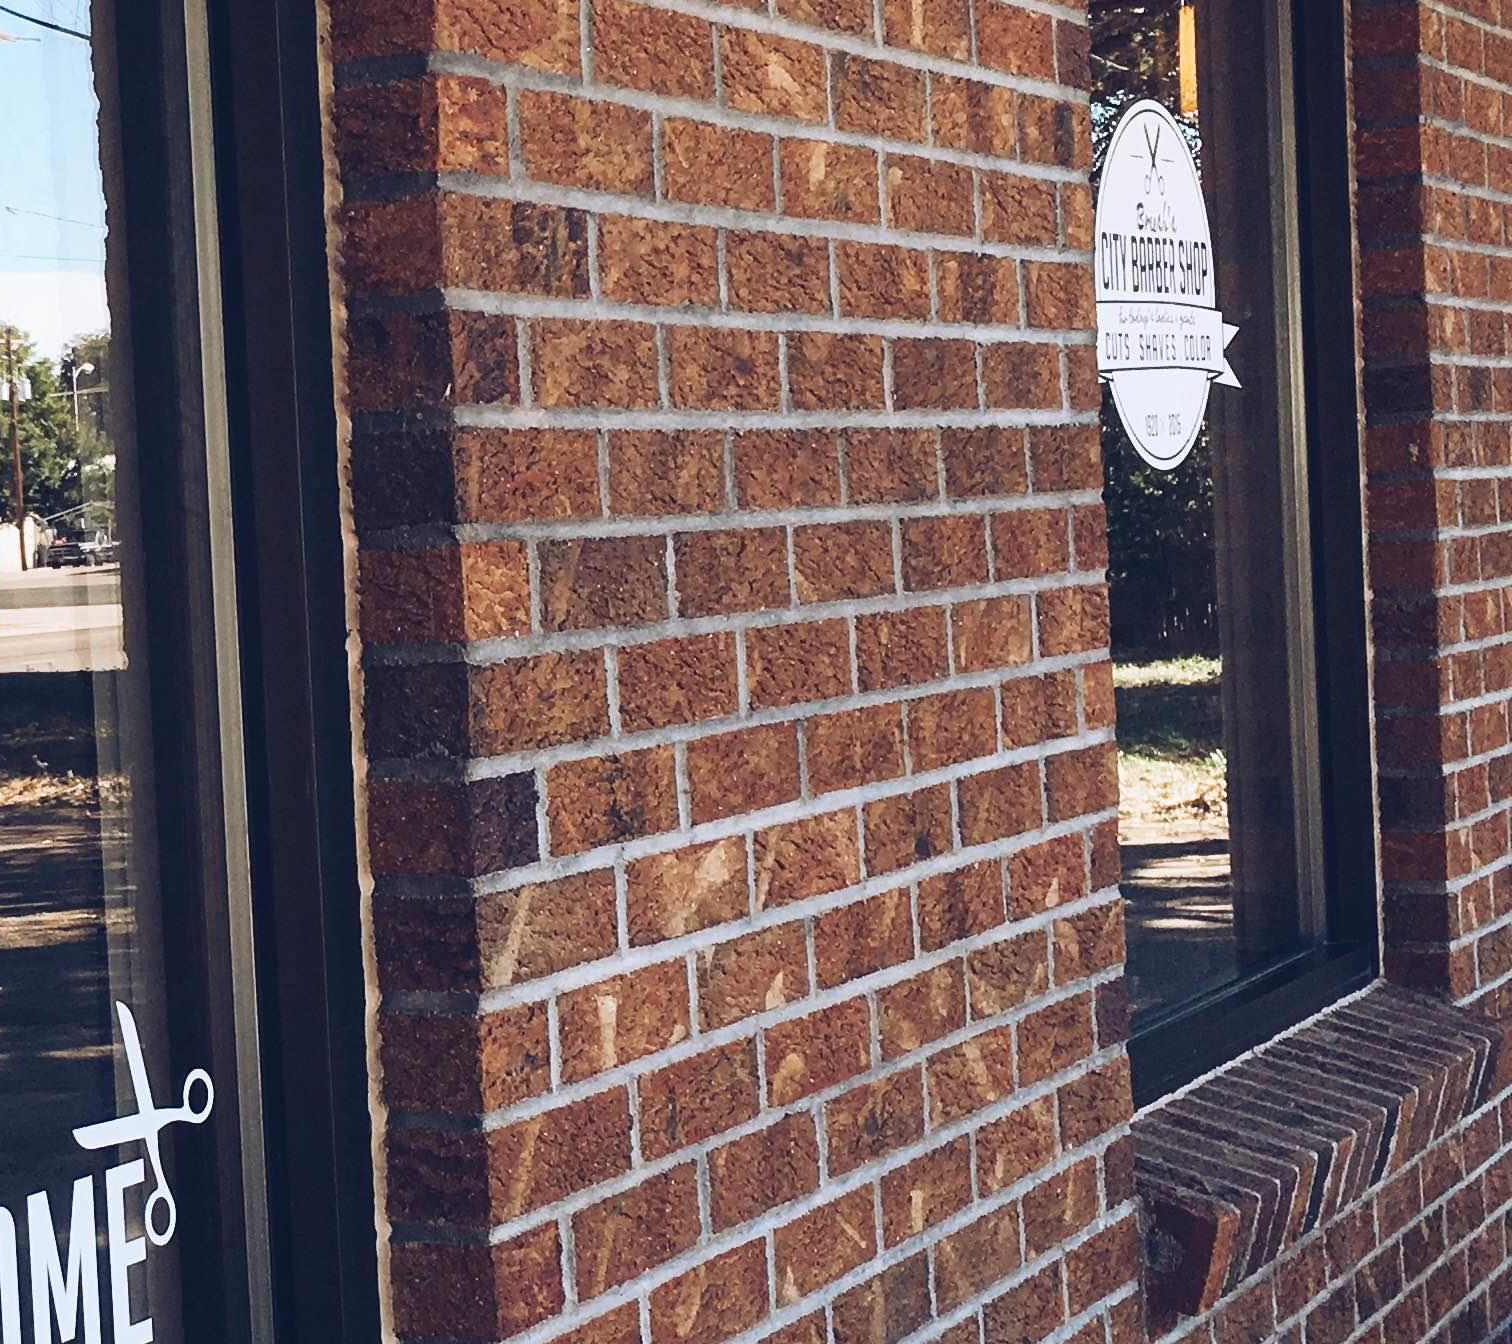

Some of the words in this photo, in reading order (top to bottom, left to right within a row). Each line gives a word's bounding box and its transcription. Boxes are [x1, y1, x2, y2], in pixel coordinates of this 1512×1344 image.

[1101, 231, 1127, 292] CITY
[1131, 235, 1177, 295] BARBER
[1178, 239, 1208, 296] SHOP
[1105, 331, 1130, 361] CUTS
[1139, 333, 1176, 361] SHAVES
[1183, 334, 1211, 361] COLOR
